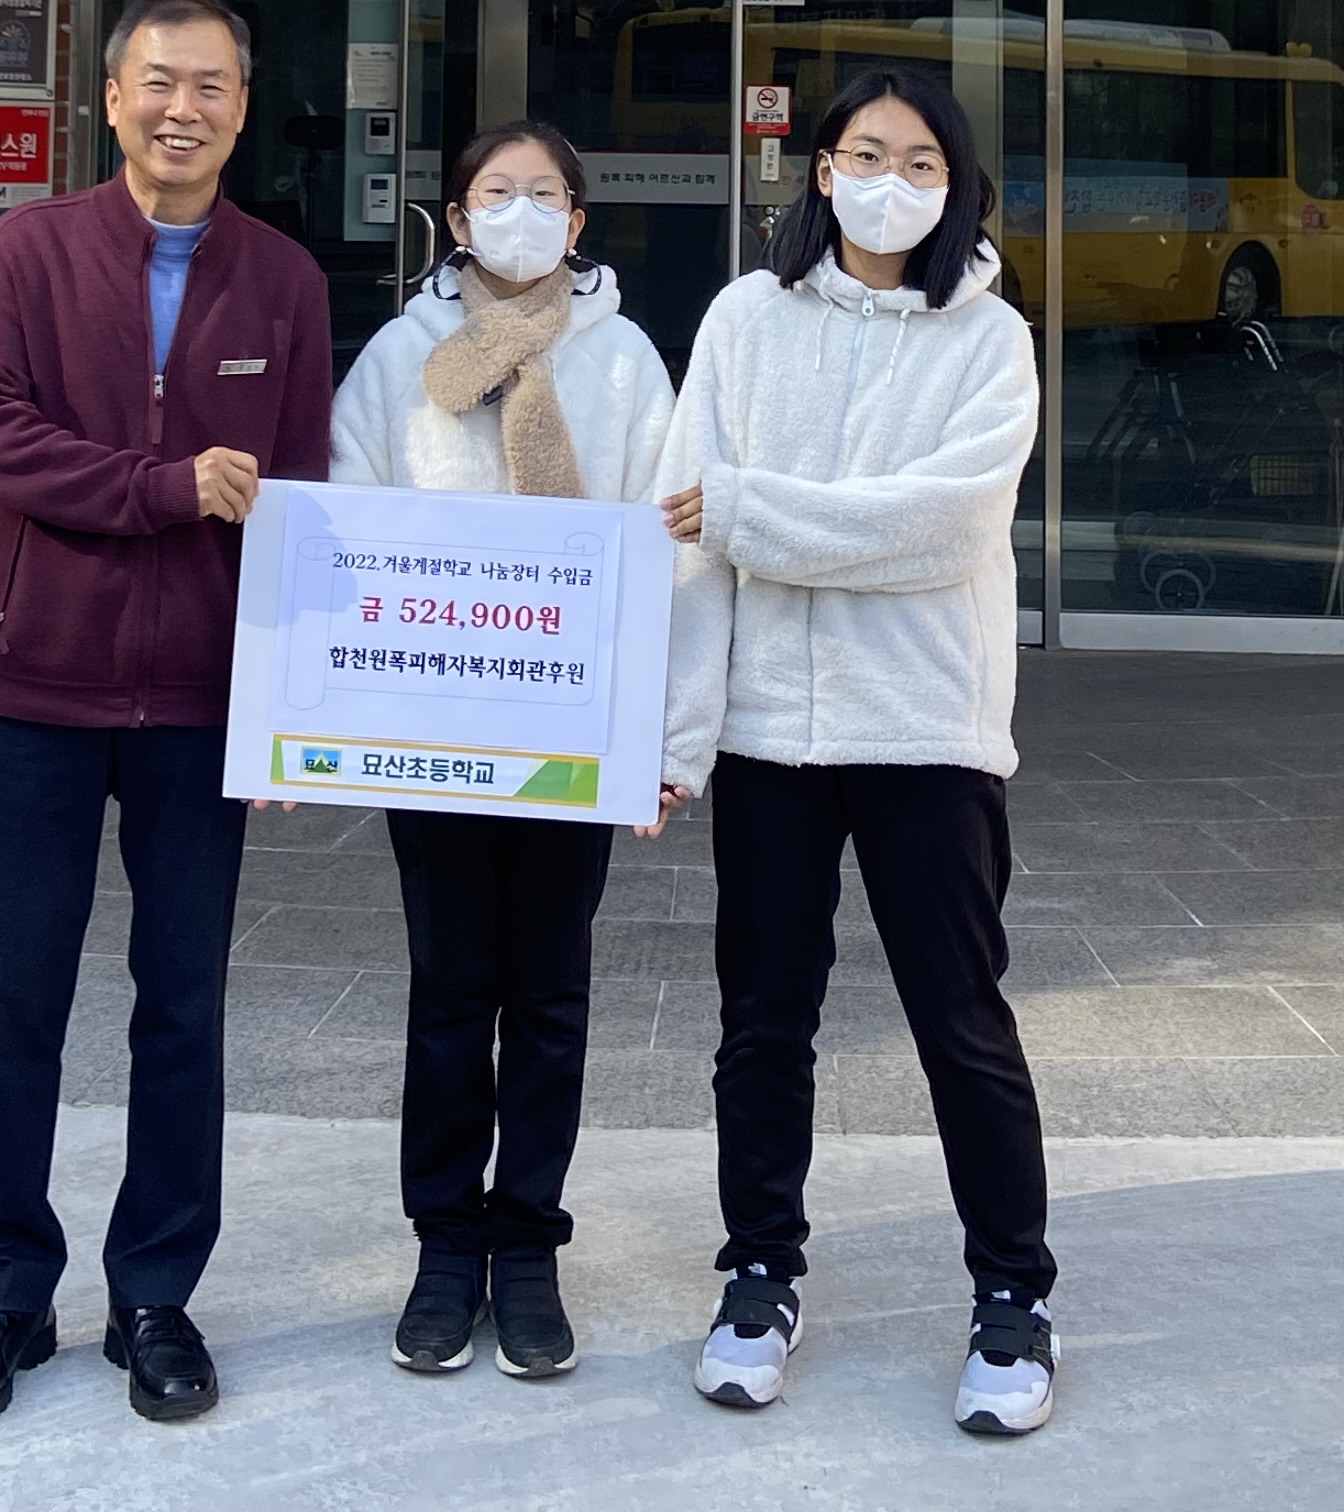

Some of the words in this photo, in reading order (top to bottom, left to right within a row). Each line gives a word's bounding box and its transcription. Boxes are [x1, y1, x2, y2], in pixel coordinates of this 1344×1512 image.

[752, 112, 784, 121] 금연구역
[481, 562, 540, 583] 나눔장터
[547, 566, 594, 586] 수입금
[359, 596, 384, 623] 금
[399, 597, 562, 635] 524,900원
[329, 645, 584, 685] 합천원폭피해자복지회관후원
[361, 752, 495, 784] 묘산초등학교
